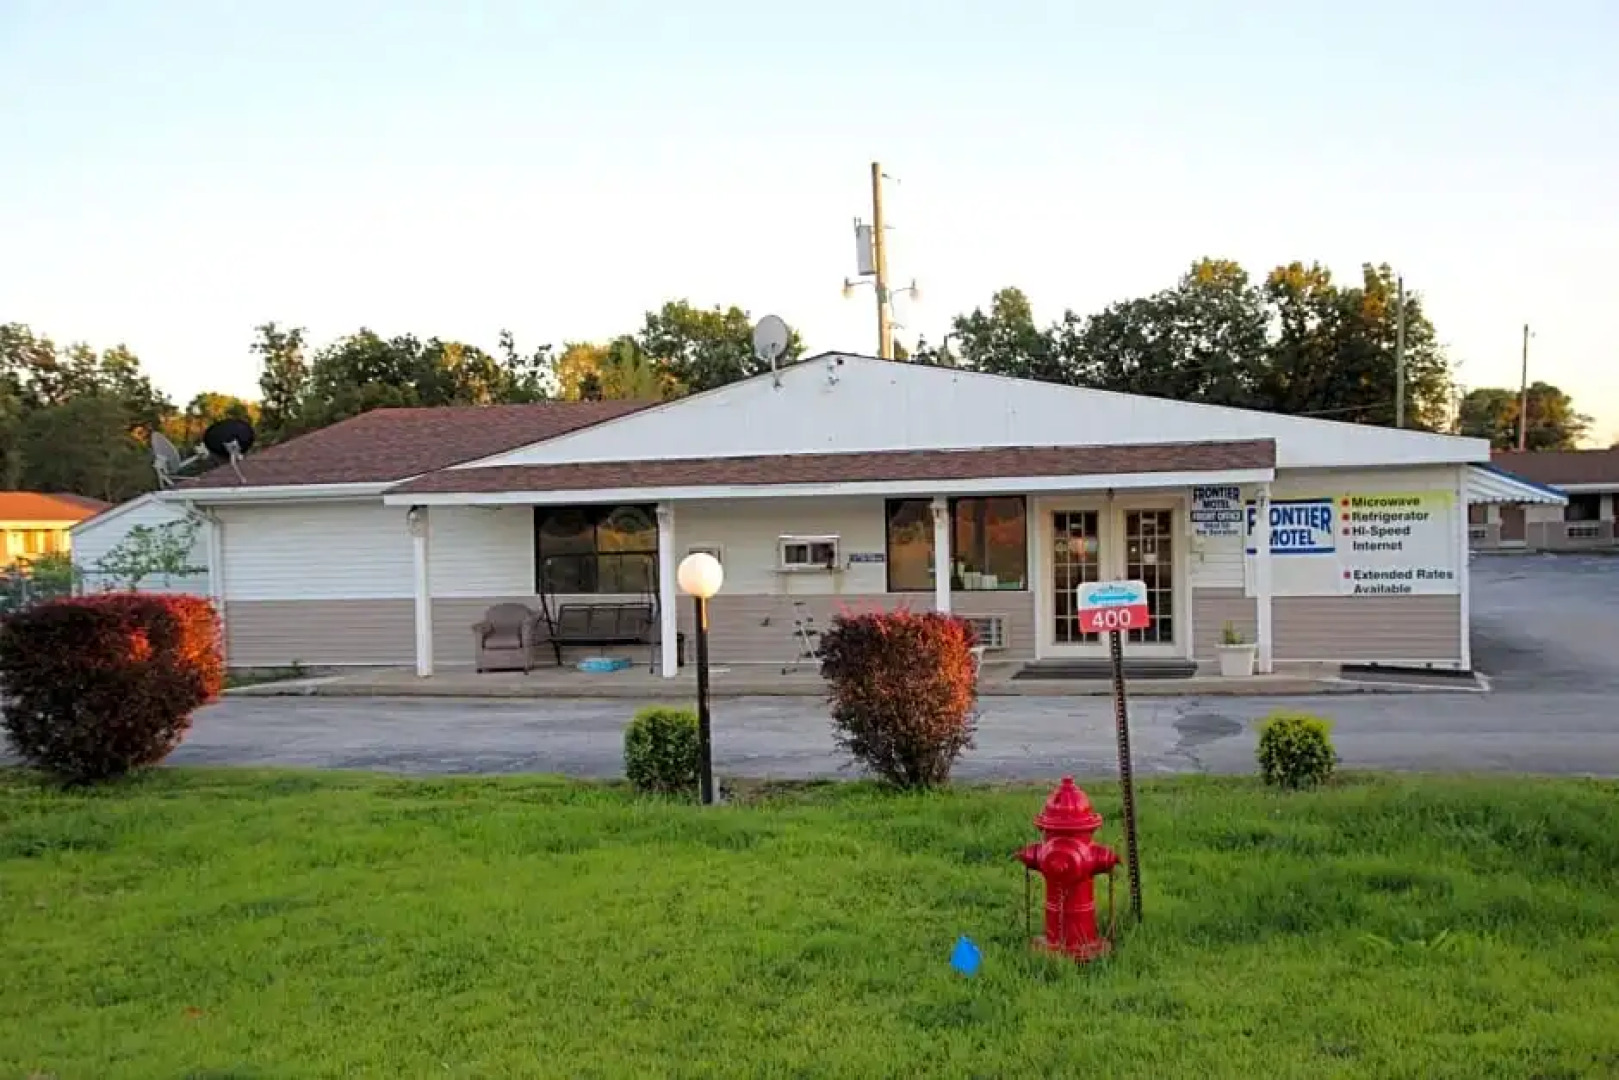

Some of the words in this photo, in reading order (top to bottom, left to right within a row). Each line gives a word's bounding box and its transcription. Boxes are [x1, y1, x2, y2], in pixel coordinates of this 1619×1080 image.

[1193, 486, 1239, 503] FRONTIER
[1203, 500, 1229, 508] MOTEL
[1352, 497, 1421, 507] Microwave
[1246, 506, 1331, 535] FONTIER
[1352, 511, 1430, 524] Refrigerator
[1352, 525, 1411, 538] Hi-Speed
[1353, 540, 1403, 551] Internet
[1353, 569, 1413, 580] Extended
[1417, 569, 1454, 580] Rates
[1354, 583, 1412, 593] Available
[1091, 609, 1131, 628] 400
